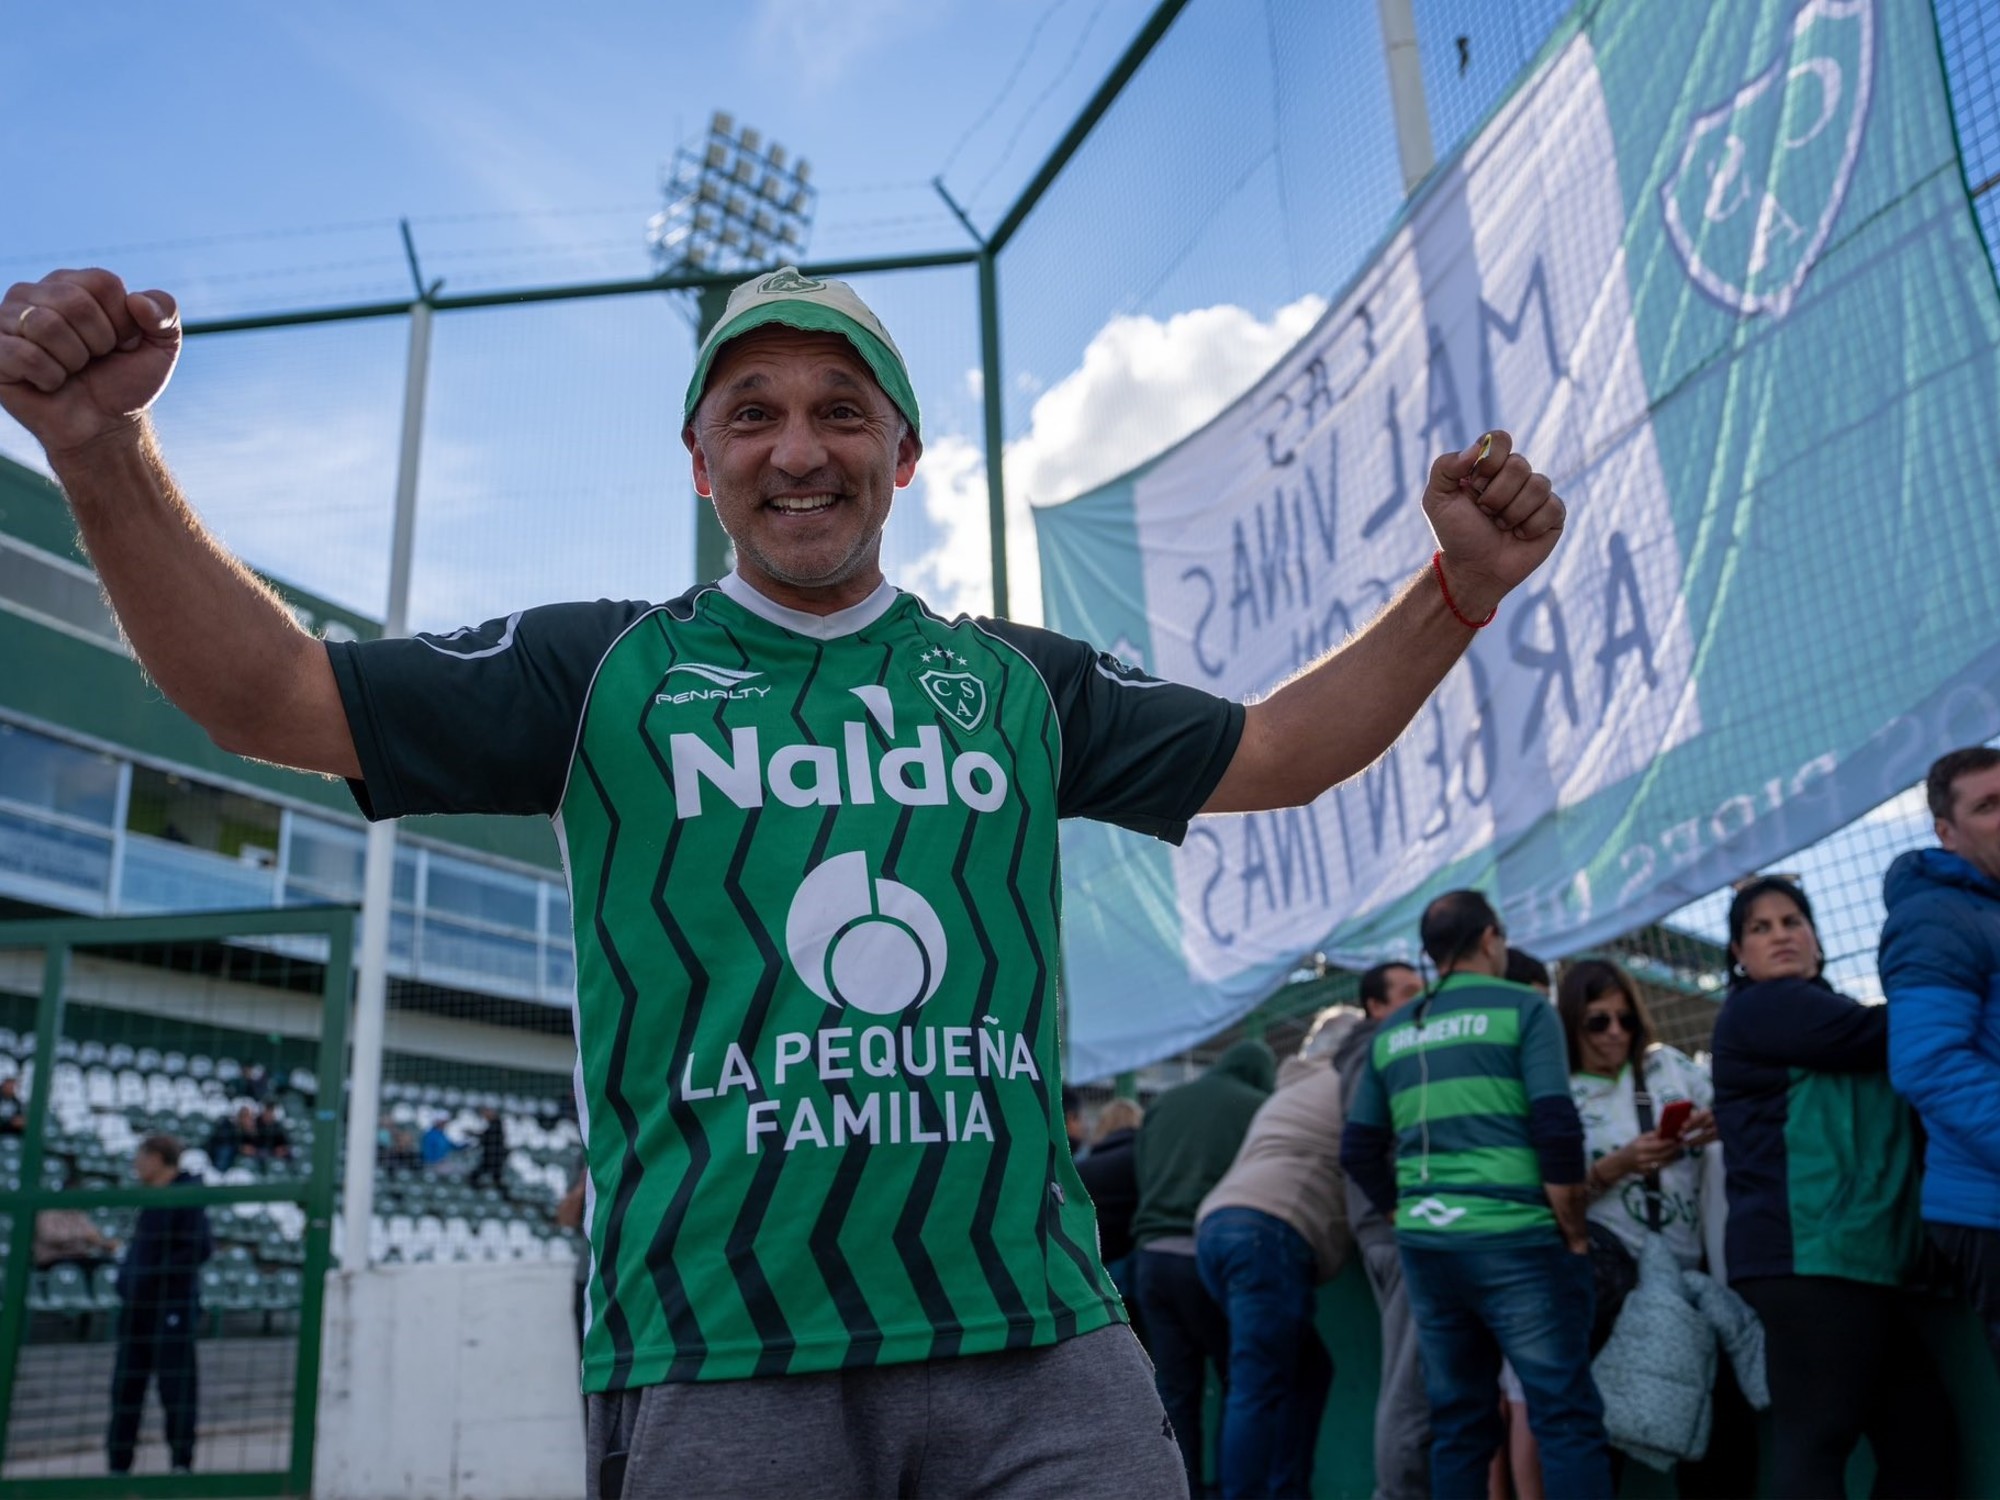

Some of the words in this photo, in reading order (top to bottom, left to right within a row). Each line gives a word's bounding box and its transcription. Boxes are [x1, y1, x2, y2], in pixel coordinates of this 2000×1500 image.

[655, 685, 771, 704] PENALTY
[670, 721, 1008, 819] Naldo
[680, 1042, 757, 1102] LA
[774, 1014, 1040, 1086] PEQUEÑA
[745, 1090, 995, 1155] FAMILIA
